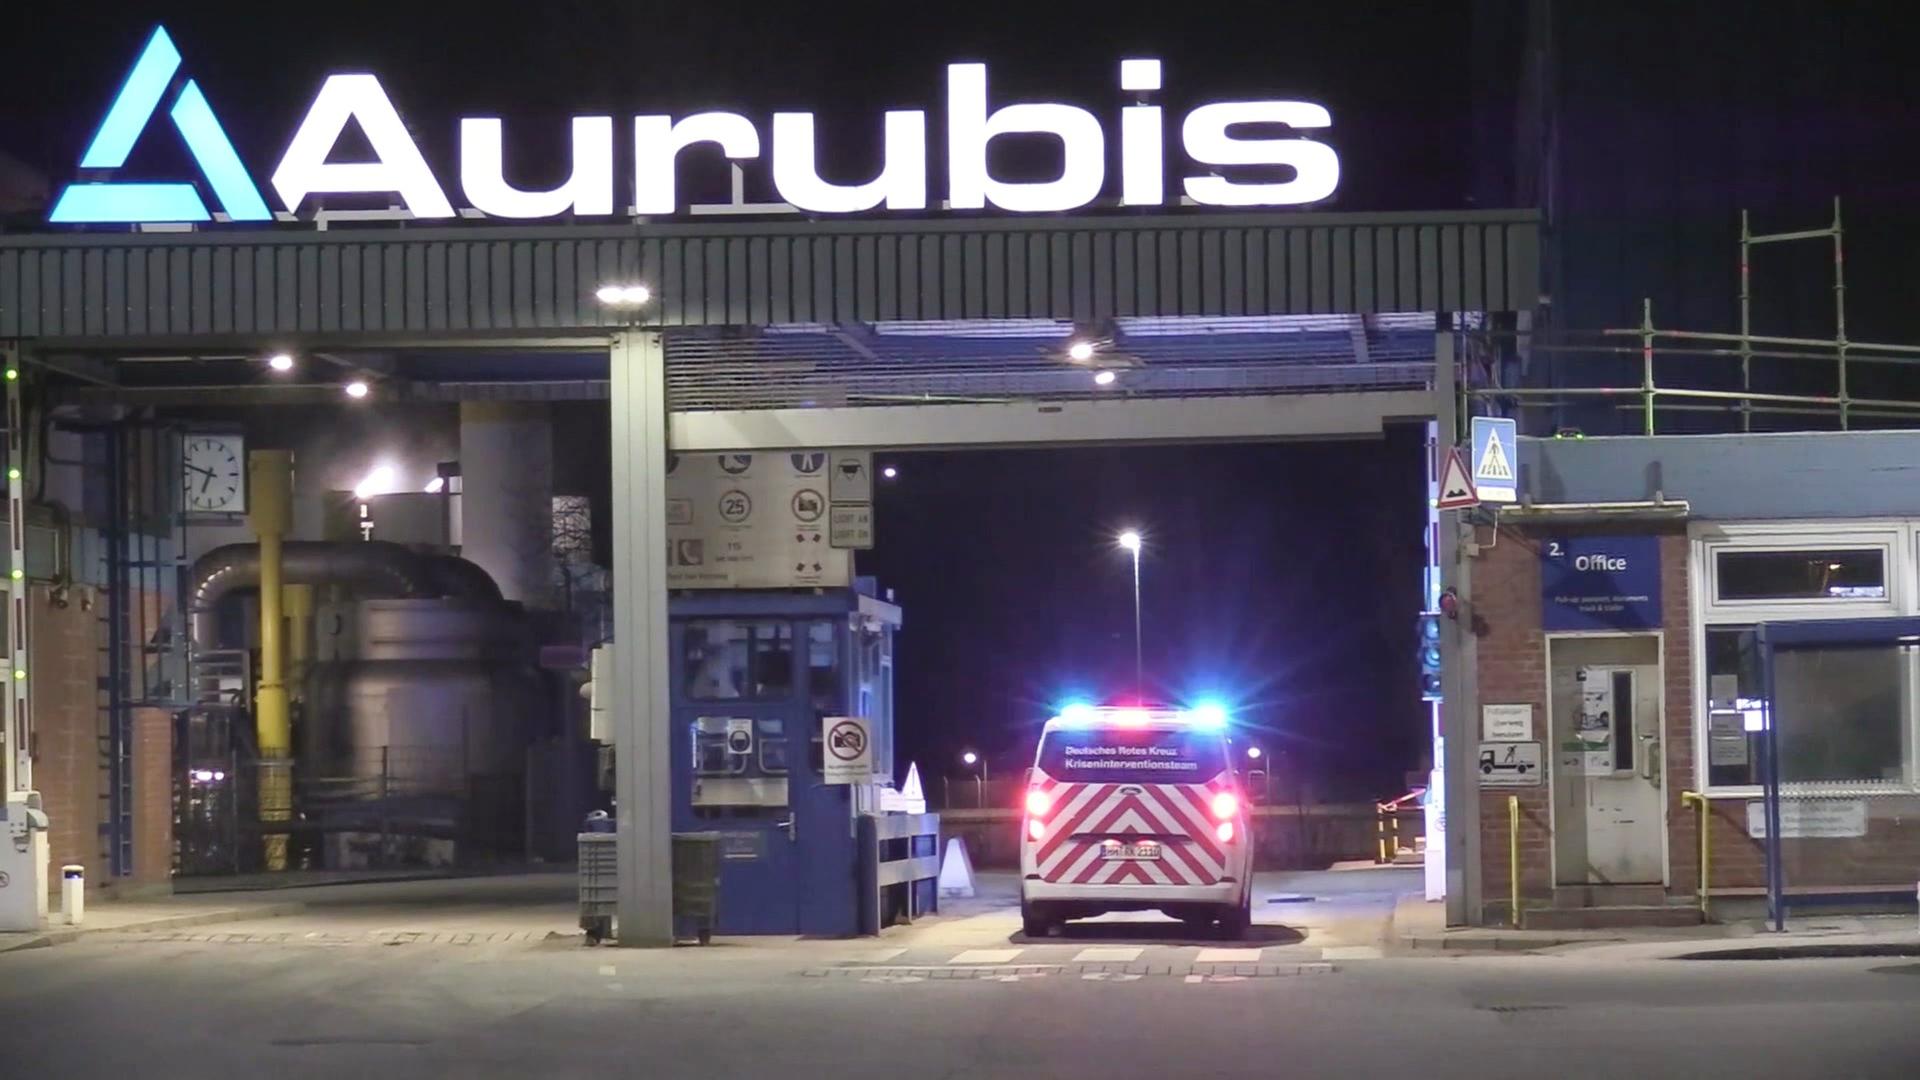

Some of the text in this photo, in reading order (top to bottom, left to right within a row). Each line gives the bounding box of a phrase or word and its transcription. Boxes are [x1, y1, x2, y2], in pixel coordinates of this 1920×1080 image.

[272, 59, 1340, 218] Aurubis
[726, 499, 745, 515] 25
[1550, 542, 1564, 556] 2.
[1575, 555, 1627, 571] Office
[1065, 746, 1177, 756] Deutsches Rotes Kreuz
[1065, 759, 1198, 770] Kriseninterventionsteam
